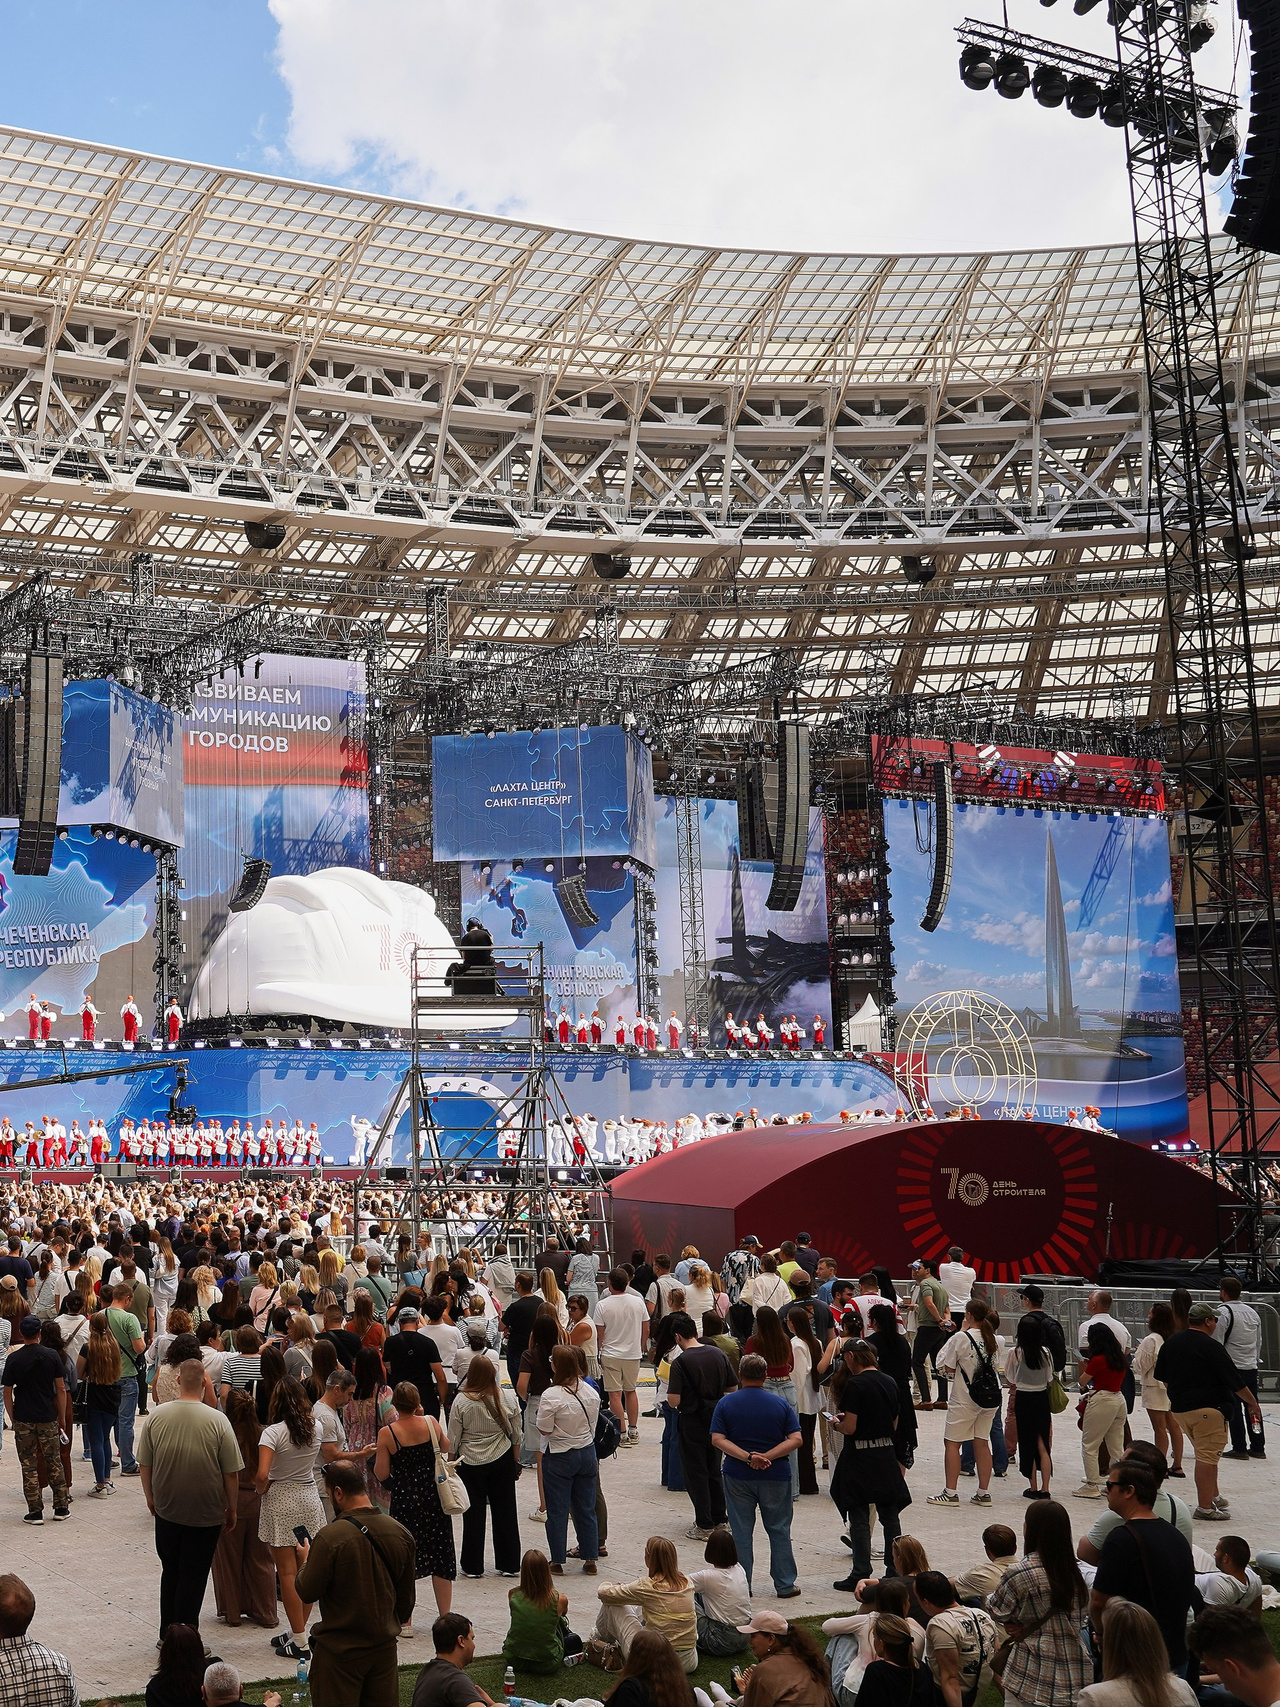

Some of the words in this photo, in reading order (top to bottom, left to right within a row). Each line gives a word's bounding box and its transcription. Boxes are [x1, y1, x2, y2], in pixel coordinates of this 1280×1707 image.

[190, 679, 301, 705] АЗВИВАЕМ
[186, 705, 332, 732] МУНИКАЦИЮ
[189, 730, 288, 753] ГОРОДОВ
[484, 795, 573, 808] САНКТ-ПЕТЕРБУРГ
[556, 981, 606, 997] ОБЛАСТЬ
[940, 1167, 989, 1206] 70
[992, 1180, 1017, 1188] ДЕНЬ
[992, 1188, 1047, 1196] СТРОИТЕЛЯ
